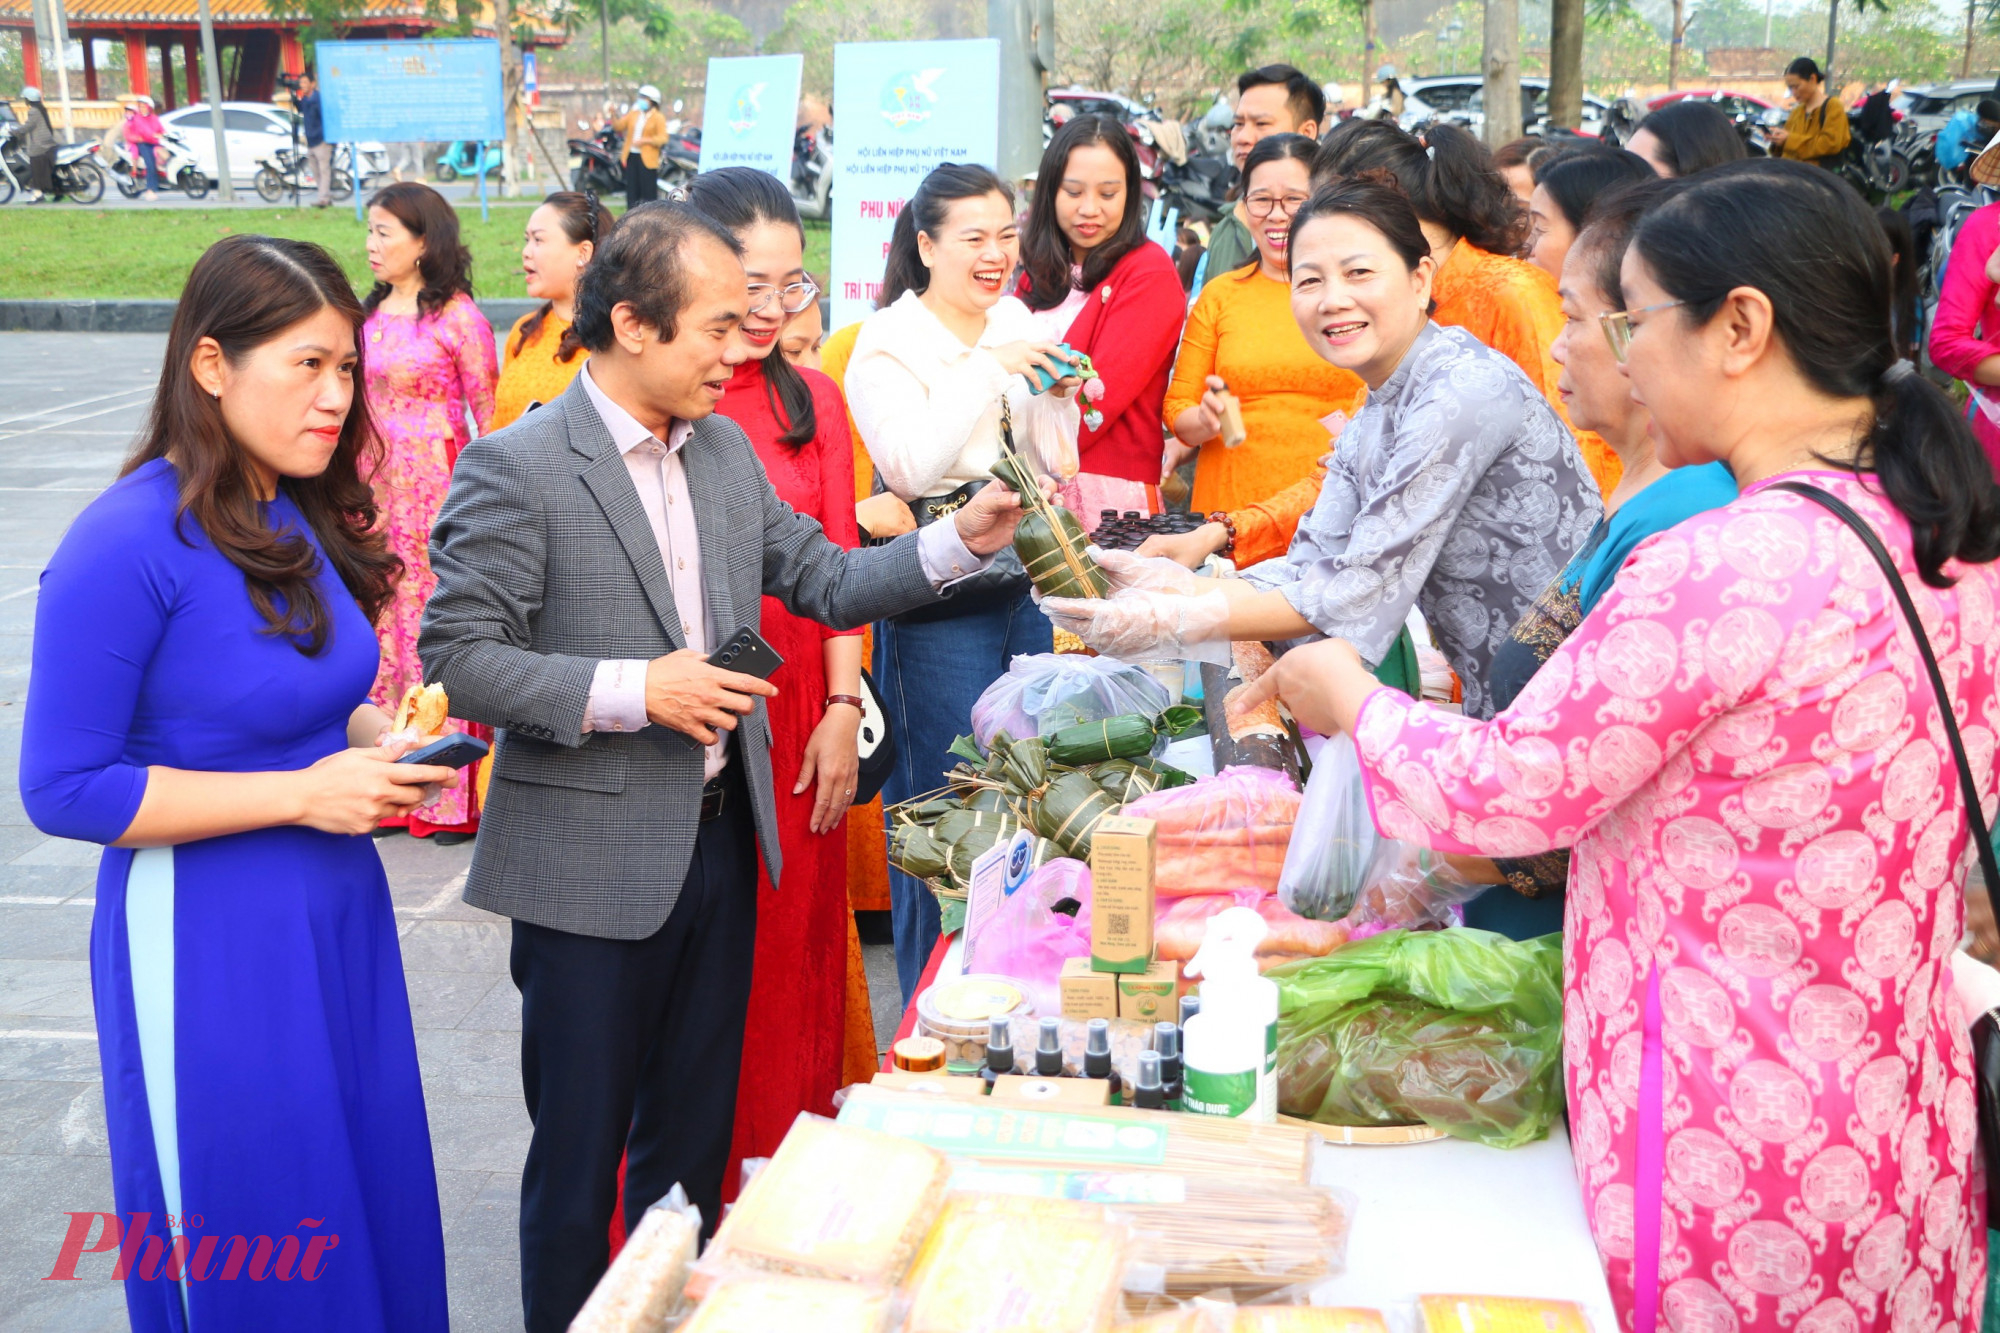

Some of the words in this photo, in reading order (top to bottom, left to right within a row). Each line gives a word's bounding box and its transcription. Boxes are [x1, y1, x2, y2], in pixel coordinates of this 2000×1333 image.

[950, 148, 967, 157] NAM
[860, 199, 884, 223] PHỤ
[844, 278, 861, 300] TRÍ
